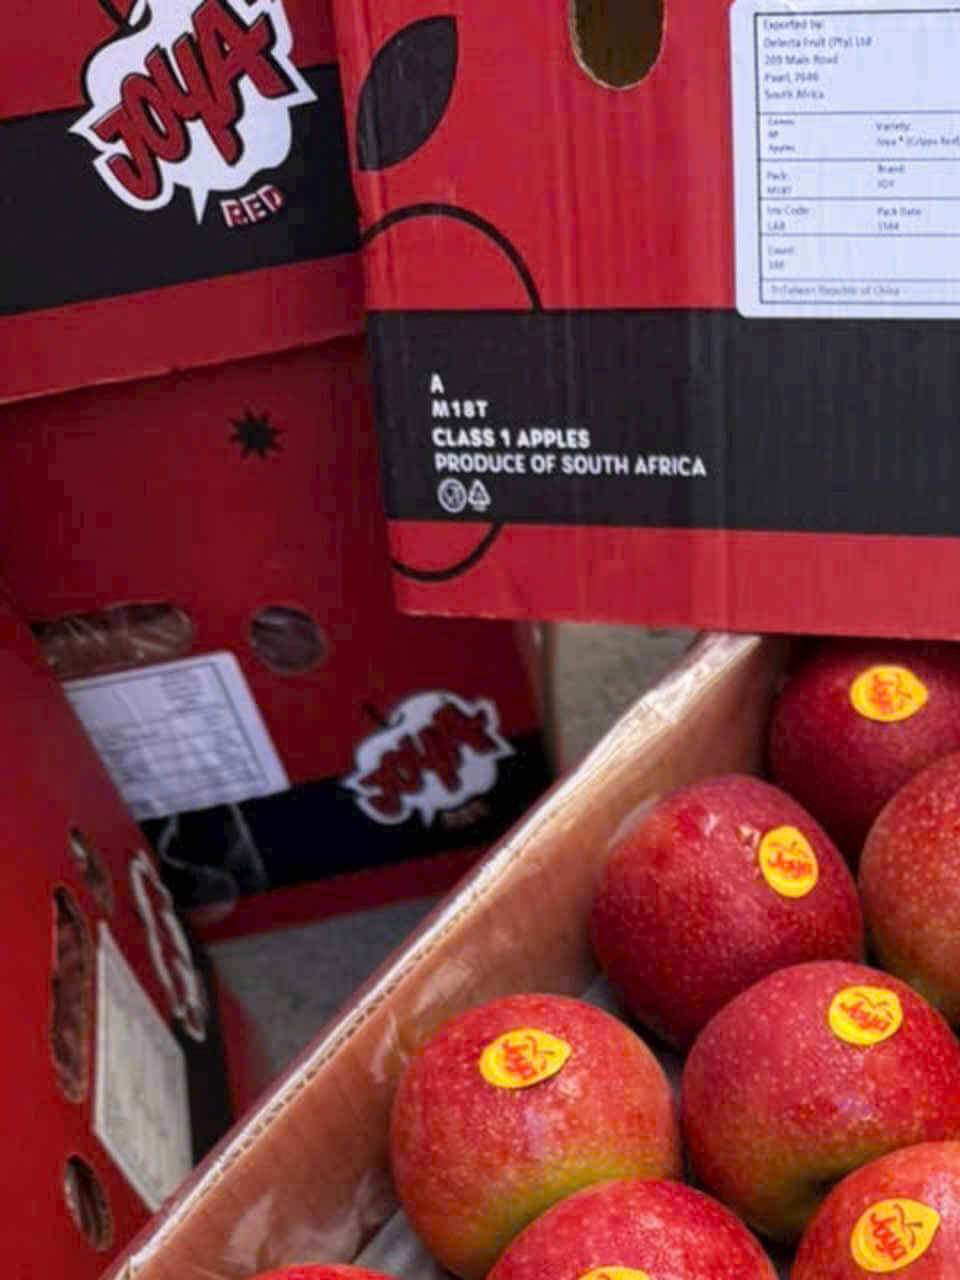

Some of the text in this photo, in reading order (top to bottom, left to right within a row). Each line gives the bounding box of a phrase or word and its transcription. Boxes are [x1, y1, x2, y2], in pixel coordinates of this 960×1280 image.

[221, 184, 284, 228] RED
[430, 373, 445, 394] A
[432, 428, 591, 449] CLASS 1 APPLES
[434, 453, 708, 478] PRODUCE OF SOUTH AFRICA
